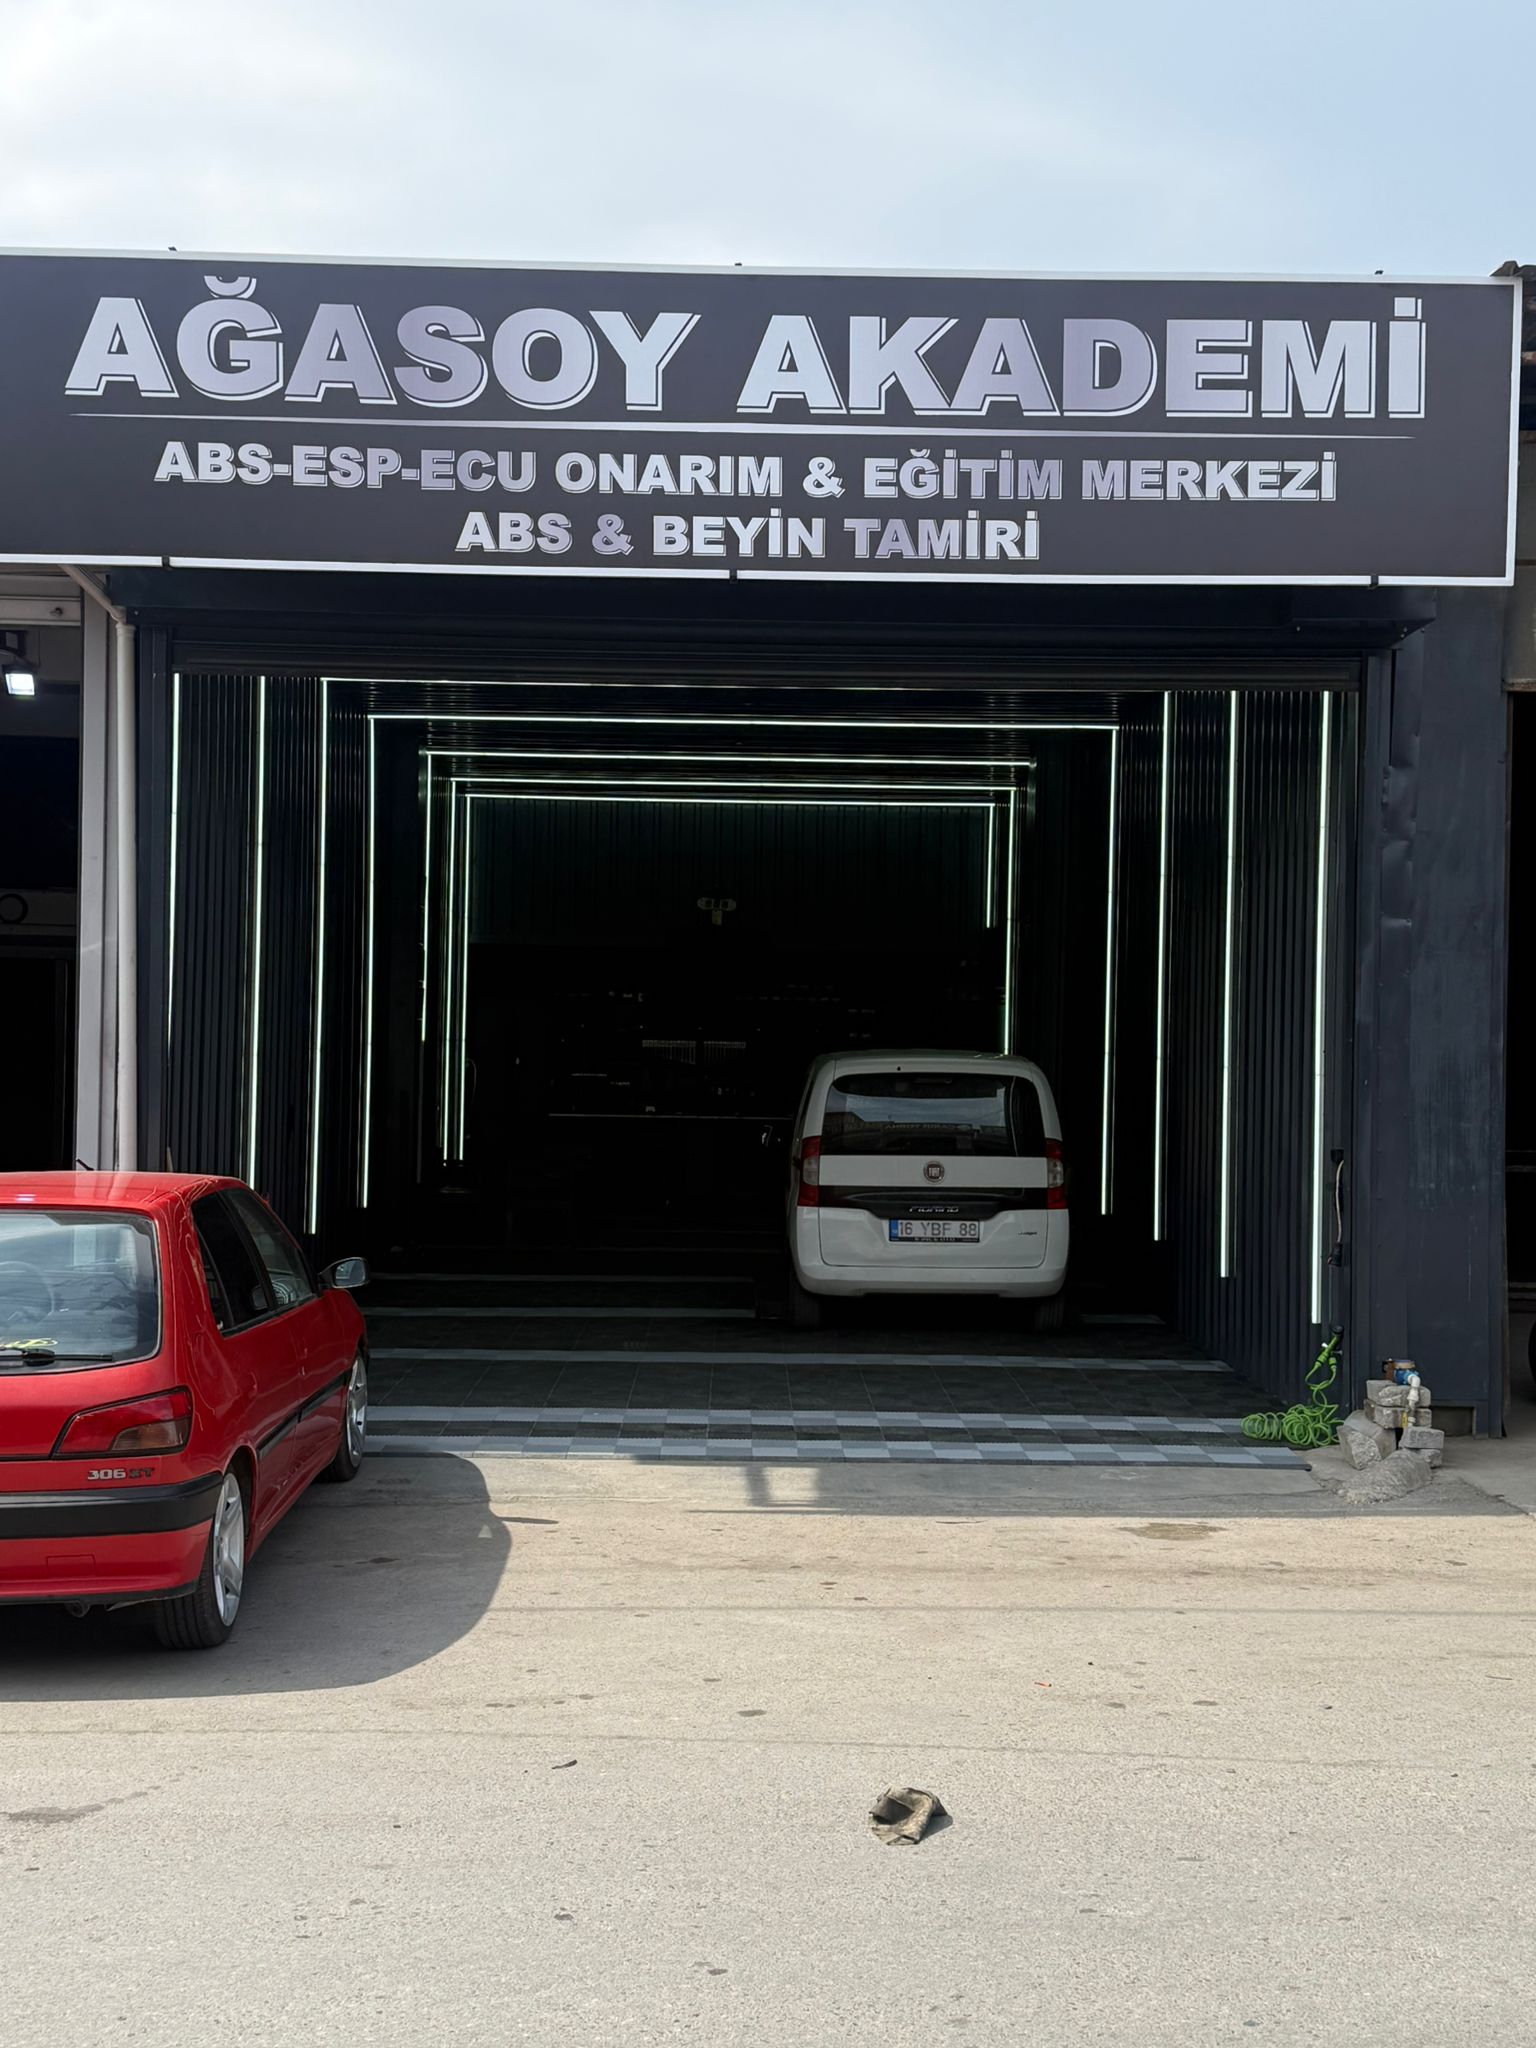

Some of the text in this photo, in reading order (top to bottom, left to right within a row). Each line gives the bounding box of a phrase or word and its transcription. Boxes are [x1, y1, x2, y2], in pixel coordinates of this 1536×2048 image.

[65, 275, 1427, 419] AĞASOY AKADEMİ
[154, 441, 1337, 501] ABS-ESP-ECU ONARIM & EĞİTİM MERKEZİ
[455, 508, 1040, 560] ABS & BEYİN TAMİRİ
[900, 1222, 913, 1236] 16
[920, 1222, 952, 1236] YBF
[959, 1223, 977, 1237] 88
[87, 1468, 126, 1480] 306
